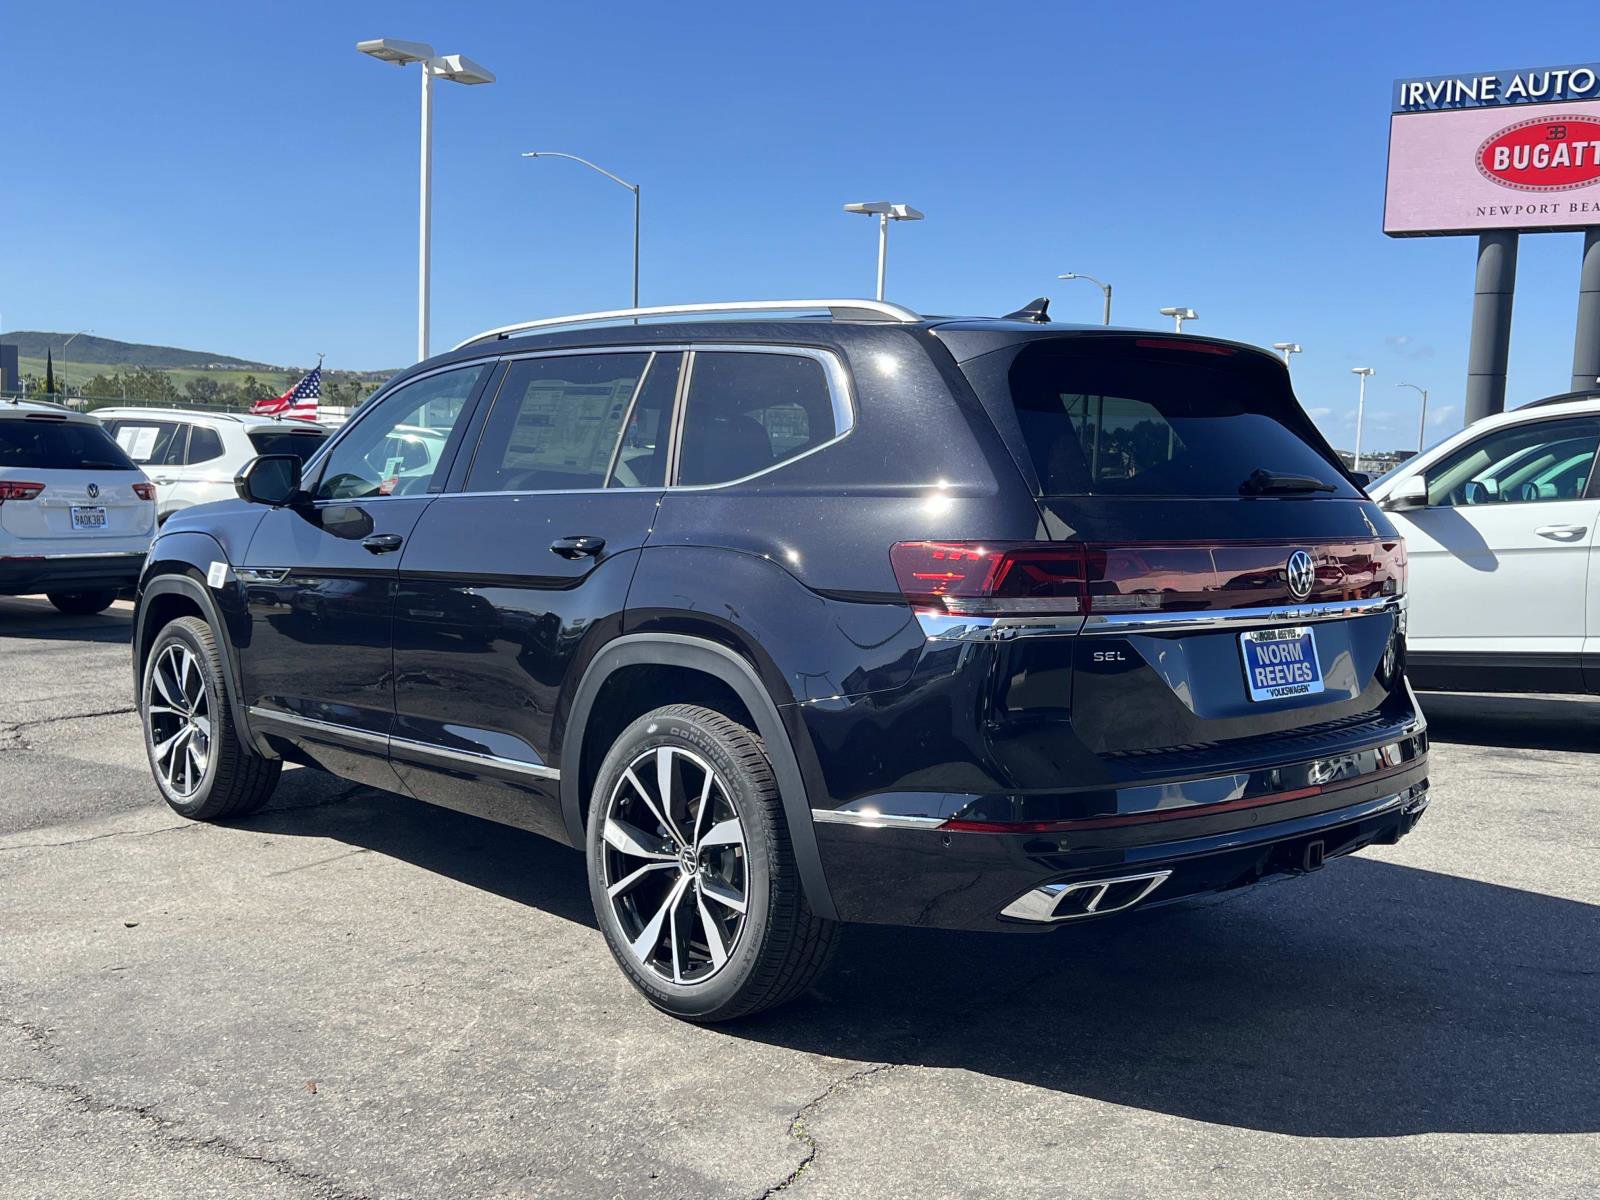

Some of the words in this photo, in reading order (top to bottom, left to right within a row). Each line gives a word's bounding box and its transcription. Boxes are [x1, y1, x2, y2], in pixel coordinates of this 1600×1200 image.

[1400, 76, 1496, 106] IRVINE
[1505, 68, 1596, 98] AUTO
[1476, 203, 1560, 217] NEWPORT
[1093, 651, 1126, 662] SEL
[1256, 643, 1304, 666] NORM
[1254, 662, 1313, 687] REEVES
